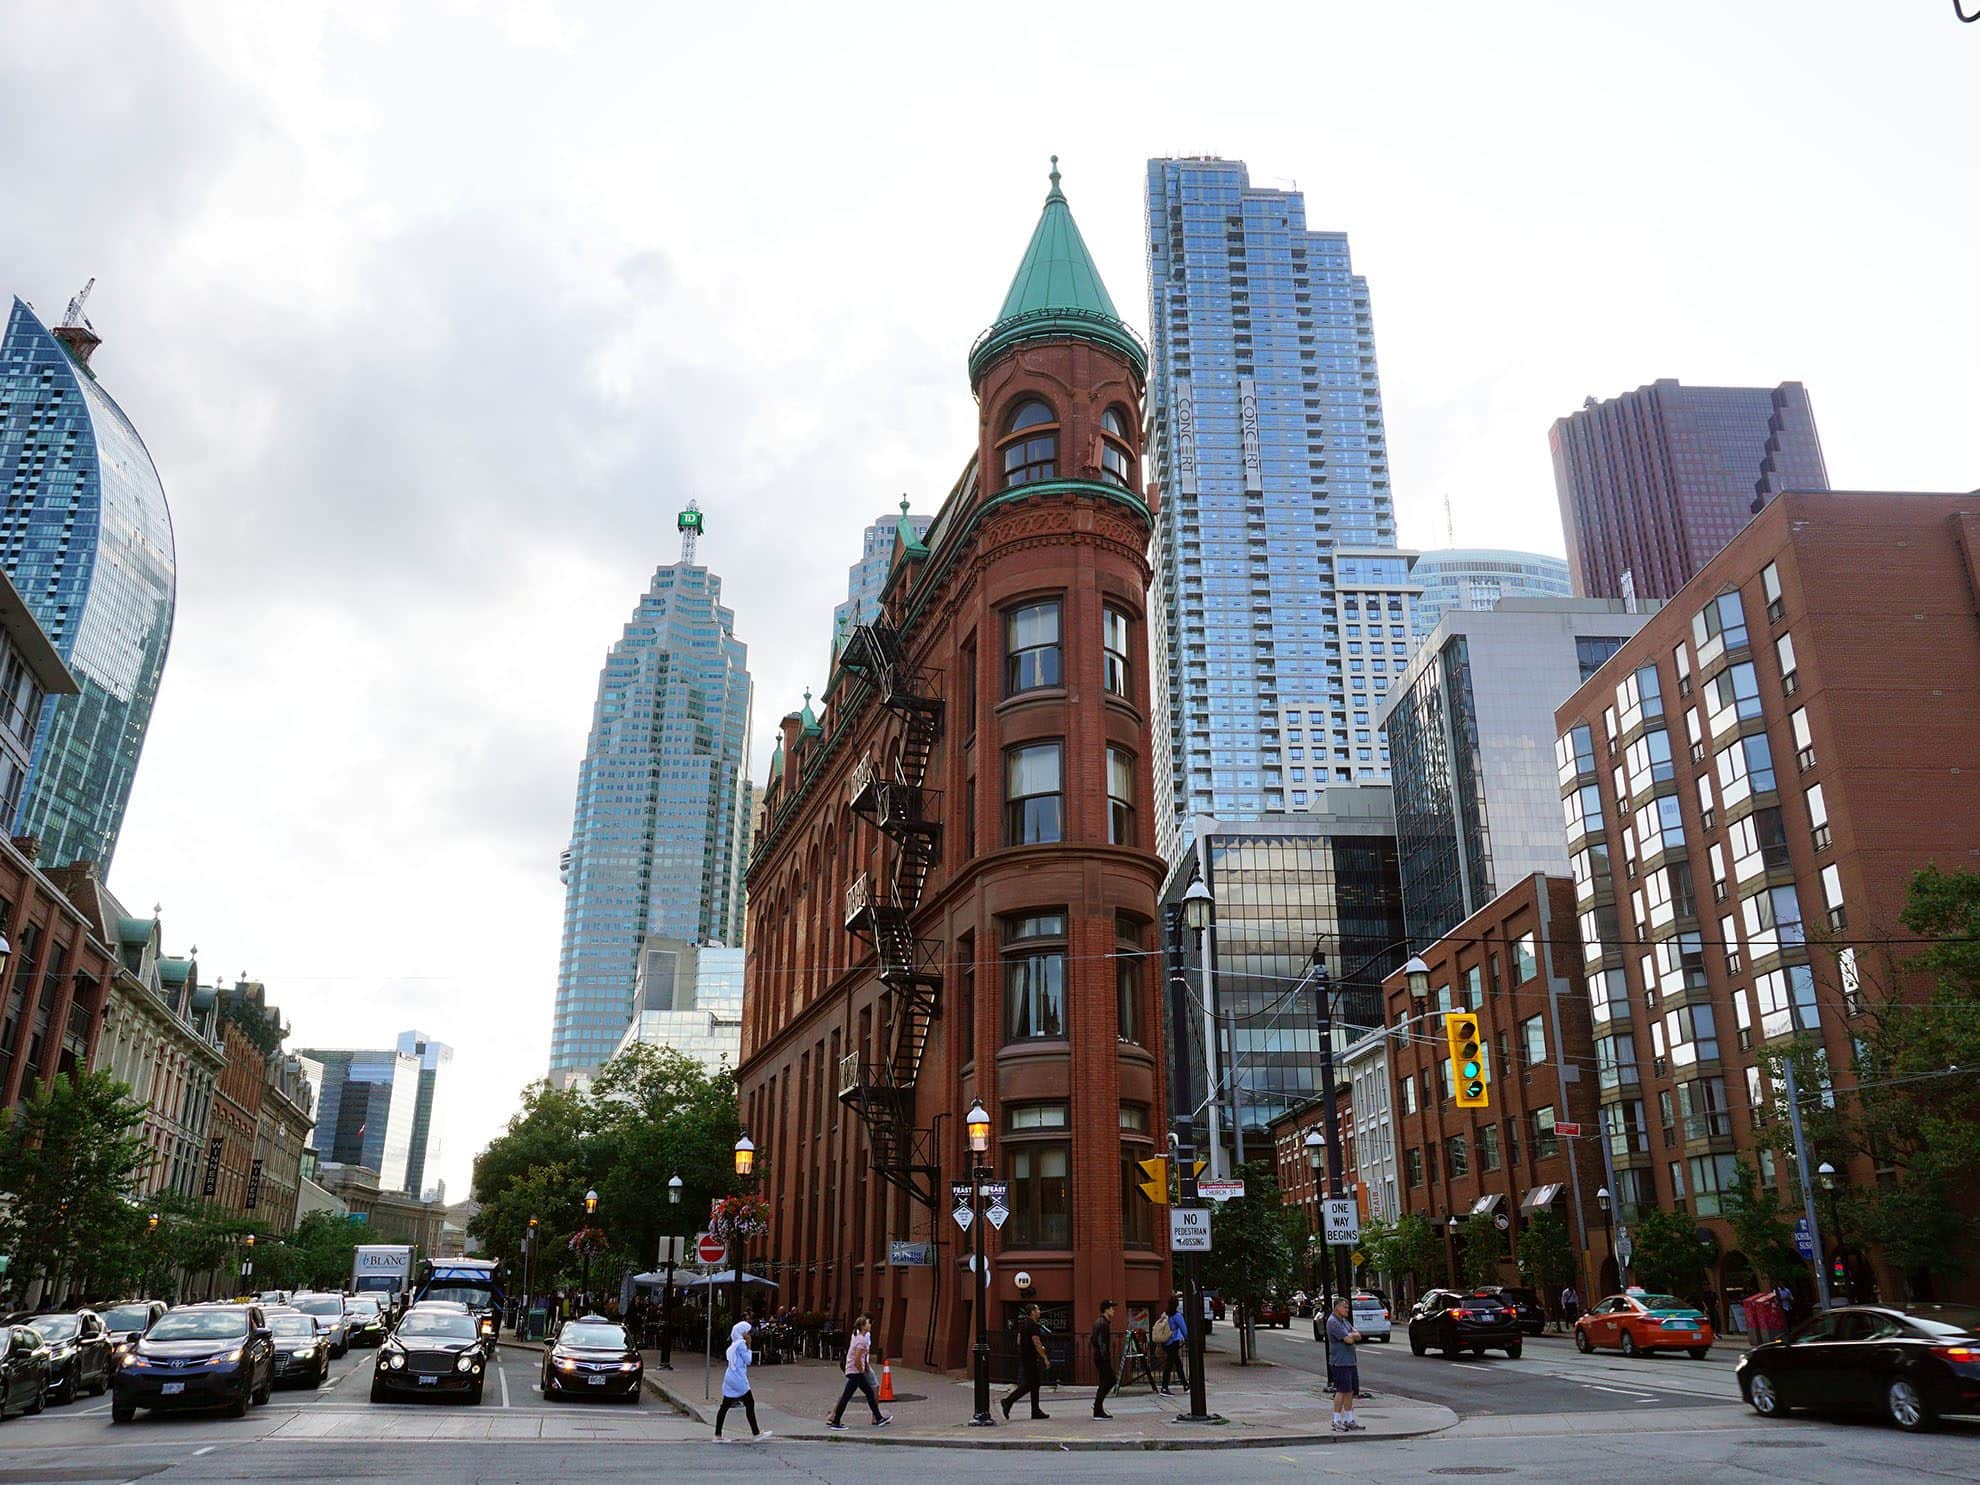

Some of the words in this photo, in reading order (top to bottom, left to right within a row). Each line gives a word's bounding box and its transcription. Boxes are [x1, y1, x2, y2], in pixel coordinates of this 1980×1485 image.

[1179, 398, 1194, 474] CONCERT
[1243, 395, 1259, 473] CONCERT
[683, 514, 696, 522] TD
[206, 1142, 223, 1192] WINNERS
[1331, 1203, 1349, 1214] ONE
[1183, 1213, 1198, 1225] NO
[1333, 1216, 1349, 1227] WAY
[1174, 1227, 1207, 1236] PEDESTRIAN
[1327, 1230, 1358, 1241] BEGINS
